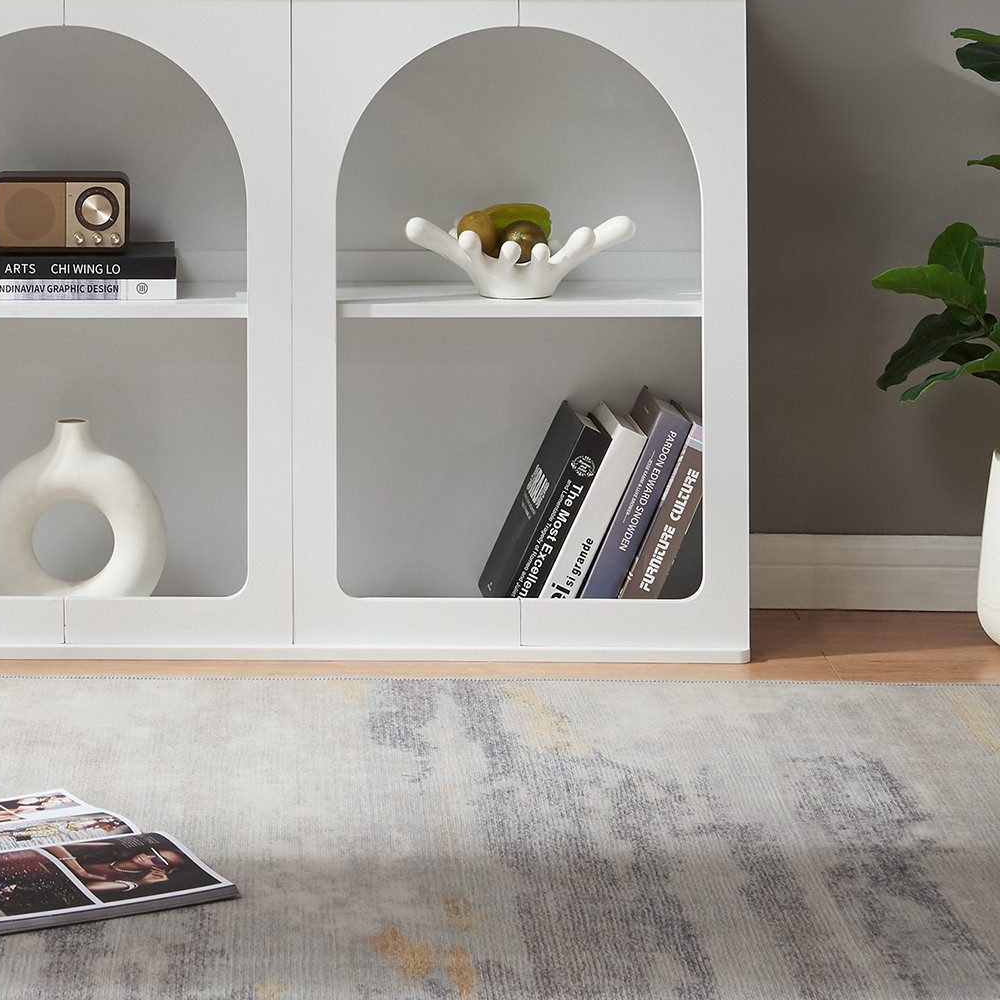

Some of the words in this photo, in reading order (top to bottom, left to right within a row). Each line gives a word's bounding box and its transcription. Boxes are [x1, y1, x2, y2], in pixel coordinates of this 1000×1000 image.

[4, 263, 36, 275] ARTS
[50, 263, 70, 275] CHI
[72, 263, 103, 275] WING
[106, 263, 121, 275] LO
[46, 284, 85, 293] GRAPHIC
[87, 284, 119, 293] DESIGN
[658, 430, 678, 465] PARDON
[564, 484, 584, 507] The
[640, 464, 661, 506] EDWARD
[669, 467, 700, 522] CULTURE
[549, 508, 571, 542] Most
[618, 505, 645, 552] SNOWDEN
[565, 575, 576, 587] si
[571, 537, 594, 576] grande
